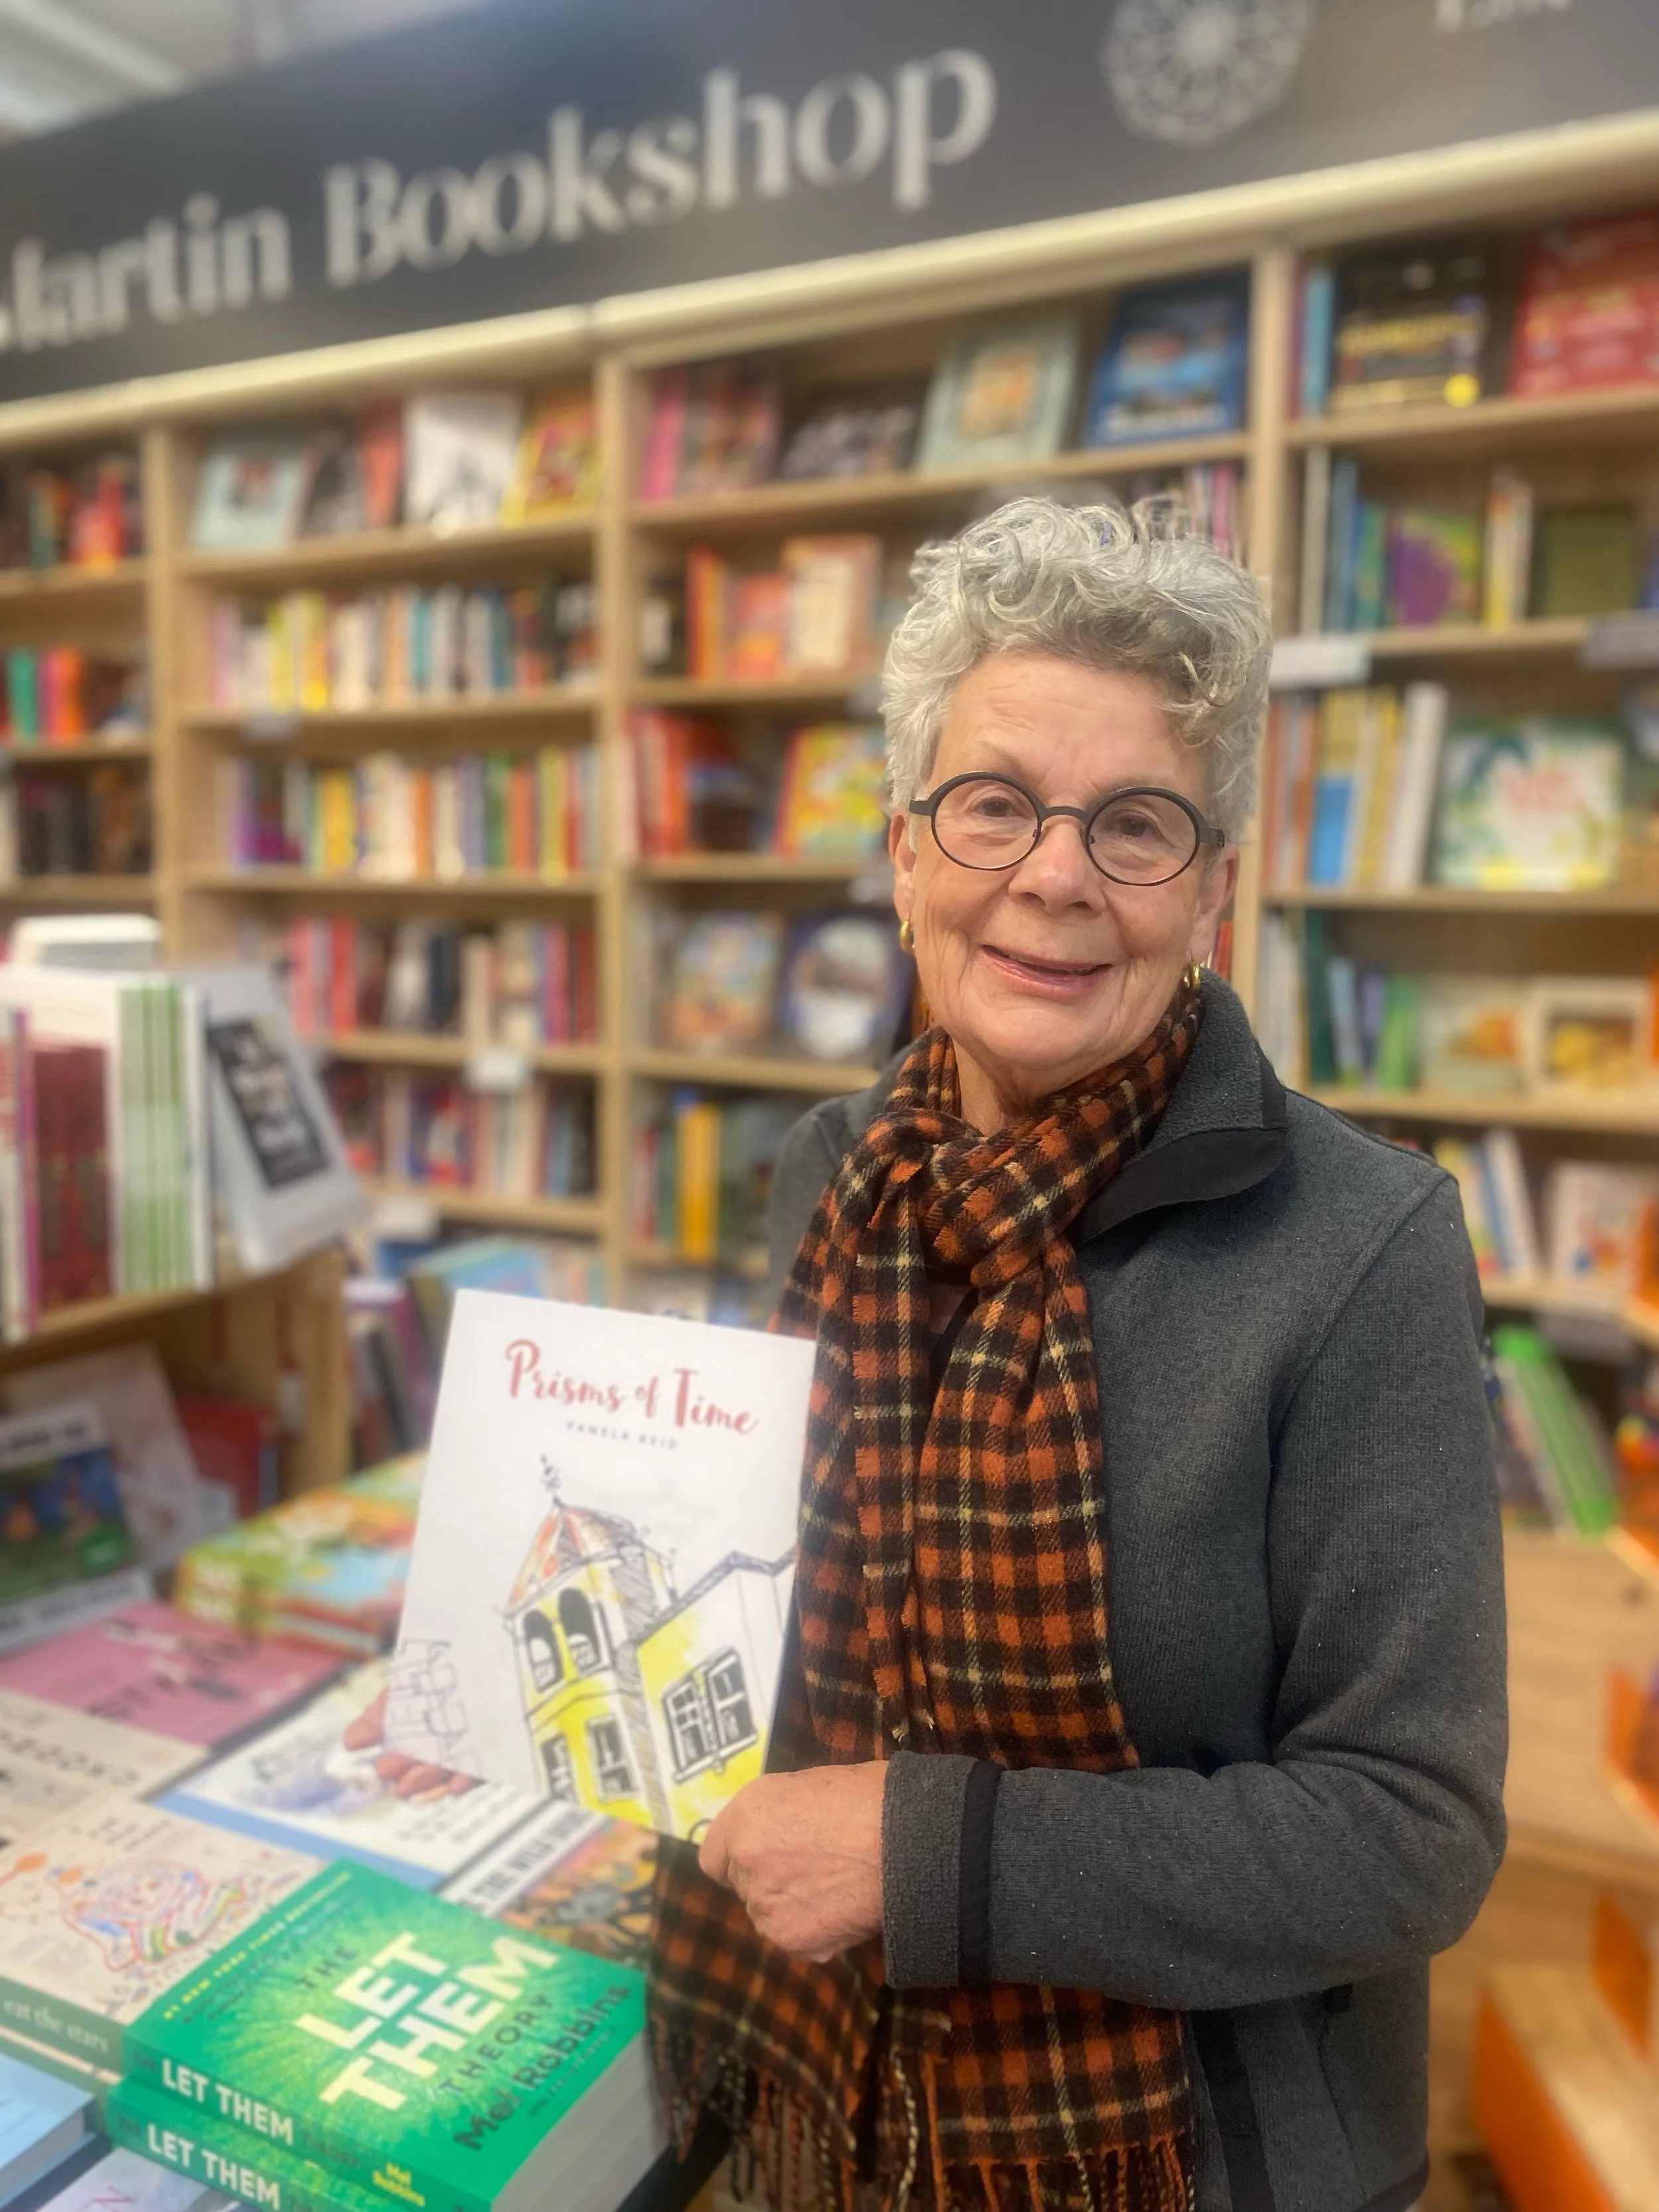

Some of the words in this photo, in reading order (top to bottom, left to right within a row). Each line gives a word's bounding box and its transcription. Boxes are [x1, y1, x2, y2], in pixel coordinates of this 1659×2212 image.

[324, 46, 997, 290] Bookshop
[505, 1339, 625, 1414] Prisms
[633, 1375, 660, 1419] of
[673, 1367, 758, 1435] Time
[566, 1420, 630, 1441] PAMELA
[638, 1433, 678, 1450] REID
[181, 1978, 212, 2004] NEW
[214, 1951, 246, 1978] YORK
[293, 1931, 449, 2050] LET
[295, 1945, 359, 1990] THE
[318, 1935, 561, 2112] THEM
[438, 1994, 553, 2096] THEORY
[452, 2089, 523, 2151] Mel
[511, 1986, 630, 2090] Robbins
[163, 2057, 209, 2103] LET
[215, 2082, 293, 2144] THEM
[147, 2122, 194, 2168] LET
[202, 2148, 280, 2211] THEM
